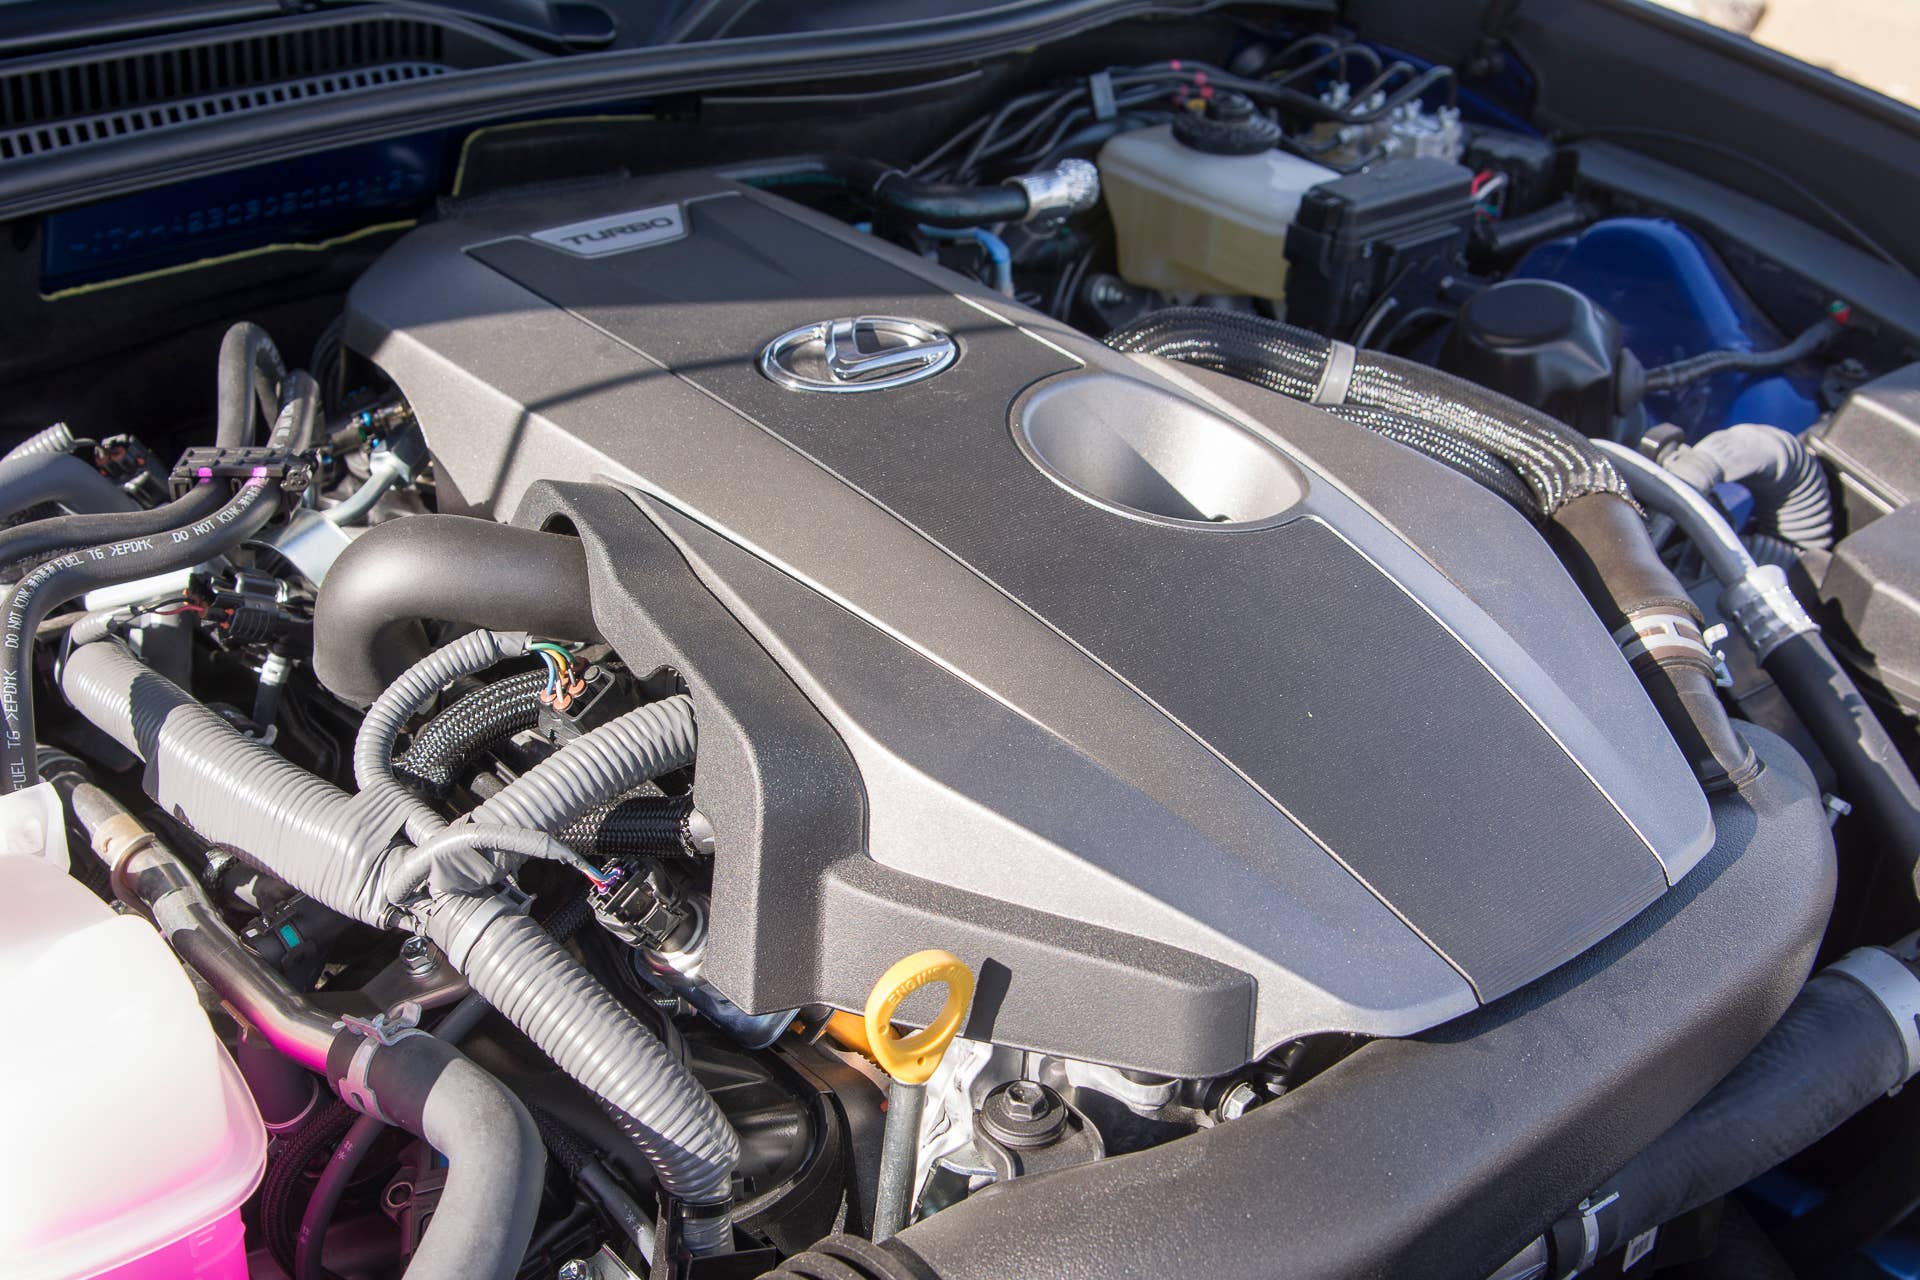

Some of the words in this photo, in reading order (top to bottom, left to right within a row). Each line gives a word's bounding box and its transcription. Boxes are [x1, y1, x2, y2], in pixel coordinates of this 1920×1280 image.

[560, 217, 674, 245] TURBO
[191, 519, 215, 536] NOT
[172, 530, 189, 543] DO
[54, 553, 85, 570] FUEL
[7, 611, 23, 630] NOT
[5, 633, 19, 649] DO
[10, 757, 27, 791] FUEL
